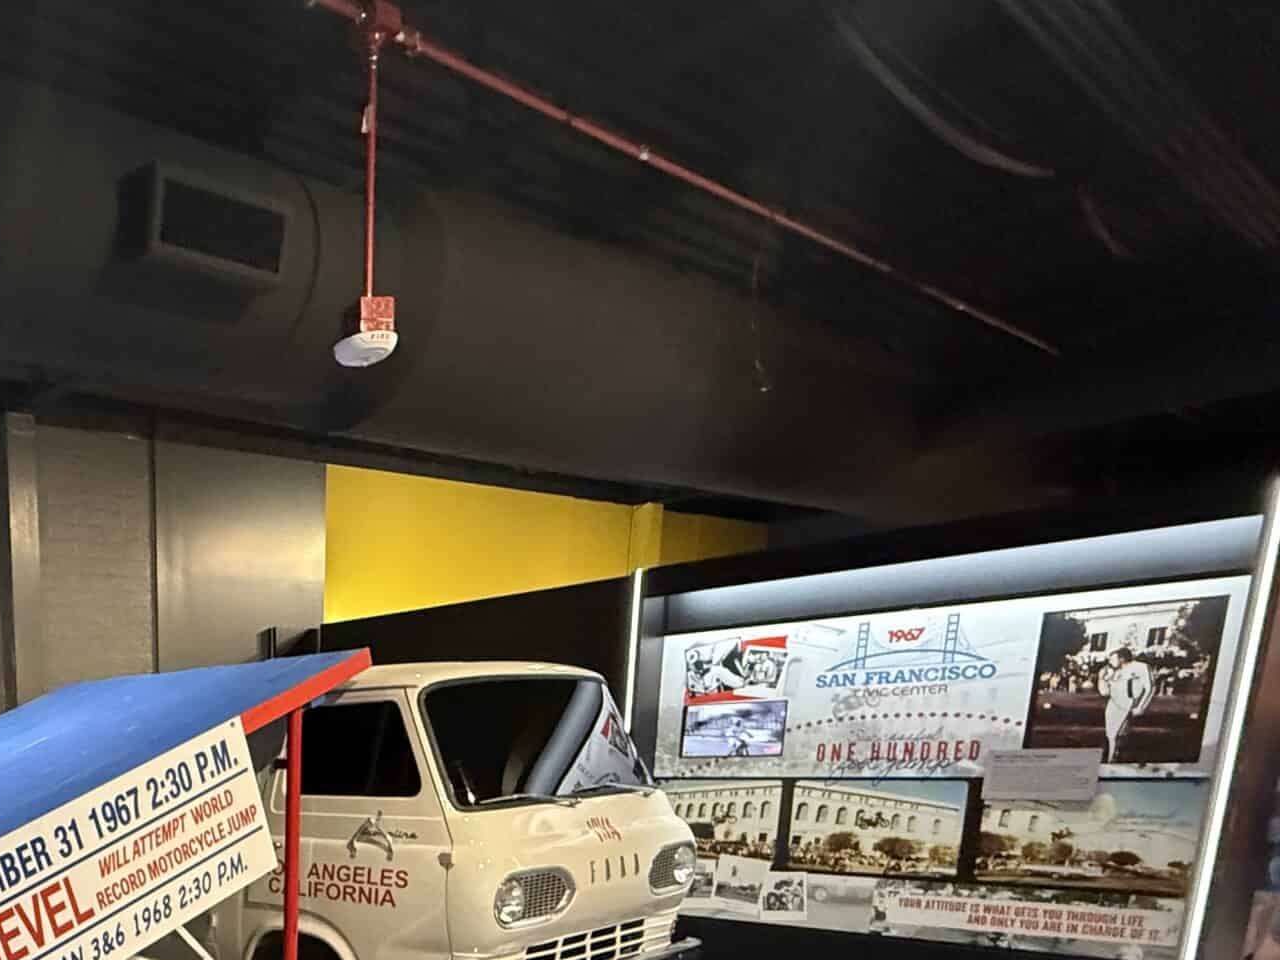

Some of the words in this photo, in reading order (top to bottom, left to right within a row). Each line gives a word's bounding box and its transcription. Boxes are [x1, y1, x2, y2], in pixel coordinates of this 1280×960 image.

[887, 627, 926, 643] 1967
[816, 673, 856, 689] SAN
[863, 663, 997, 685] FRANCISCO
[891, 683, 949, 697] CENTER
[816, 742, 857, 763] ONE
[870, 740, 981, 762] HUNDRED
[54, 818, 85, 859] 31
[89, 786, 141, 839] 1967
[146, 762, 192, 810] 2:30
[195, 740, 239, 783] P.M.
[99, 846, 131, 878] WILL
[132, 814, 187, 861] ATTEMPT
[191, 790, 233, 825] WORLD
[96, 869, 147, 910] RECORD
[147, 823, 226, 881] MOTORCYCLE
[227, 804, 257, 835] JUMP
[307, 862, 409, 889] ANGELES
[134, 895, 172, 937] 1968
[179, 871, 212, 909] 2:30
[217, 853, 248, 887] P.M.
[268, 877, 397, 908] CLIFORNIA
[924, 899, 968, 913] ATTITUDE
[983, 904, 1010, 916] WHAT
[1042, 908, 1063, 920] YOU
[1067, 910, 1117, 925] THROUGH
[1121, 913, 1145, 928] LIFE
[967, 914, 987, 926] AND
[990, 916, 1016, 929] ONLY
[1019, 919, 1039, 930] YOU
[1041, 921, 1062, 933] ARE
[1066, 923, 1079, 934] IN
[1081, 924, 1125, 939] CHARGE
[1130, 927, 1143, 939] OF
